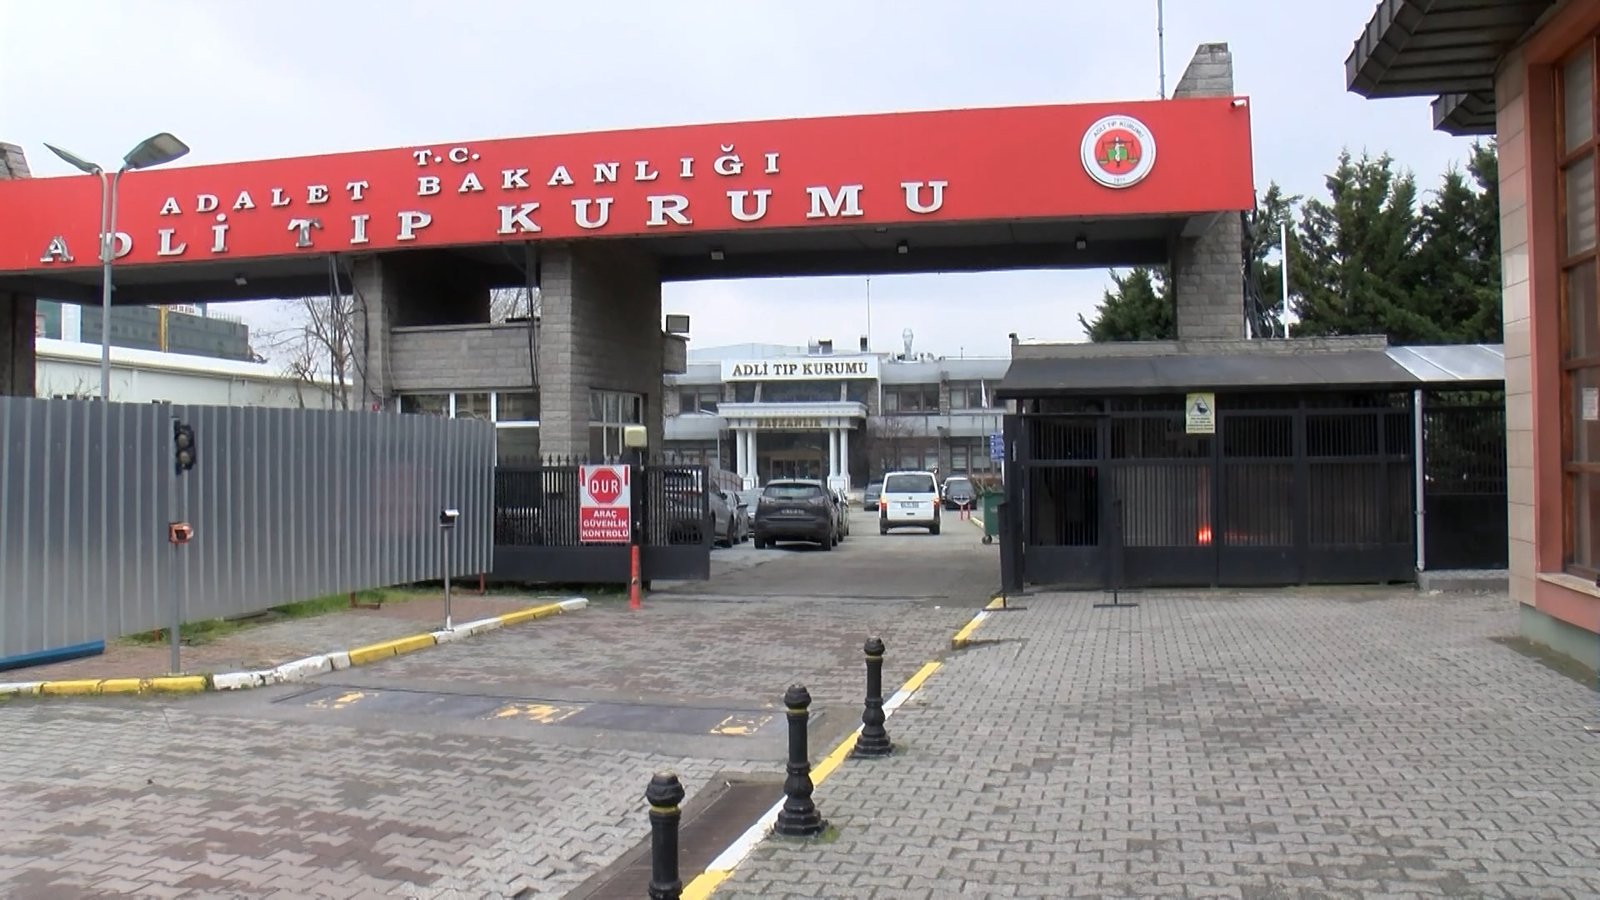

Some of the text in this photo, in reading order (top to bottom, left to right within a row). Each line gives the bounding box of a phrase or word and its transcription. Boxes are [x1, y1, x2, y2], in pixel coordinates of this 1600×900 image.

[413, 147, 480, 167] T.C.
[159, 143, 781, 216] ADALET BAKANLIĞI
[39, 181, 949, 264] ADLİ TIP KURUMU
[732, 361, 869, 377] ADLİ TIP KURUMU
[591, 479, 619, 494] DUR
[593, 509, 618, 519] ARAÇ
[583, 518, 628, 528] GÜVENLİK
